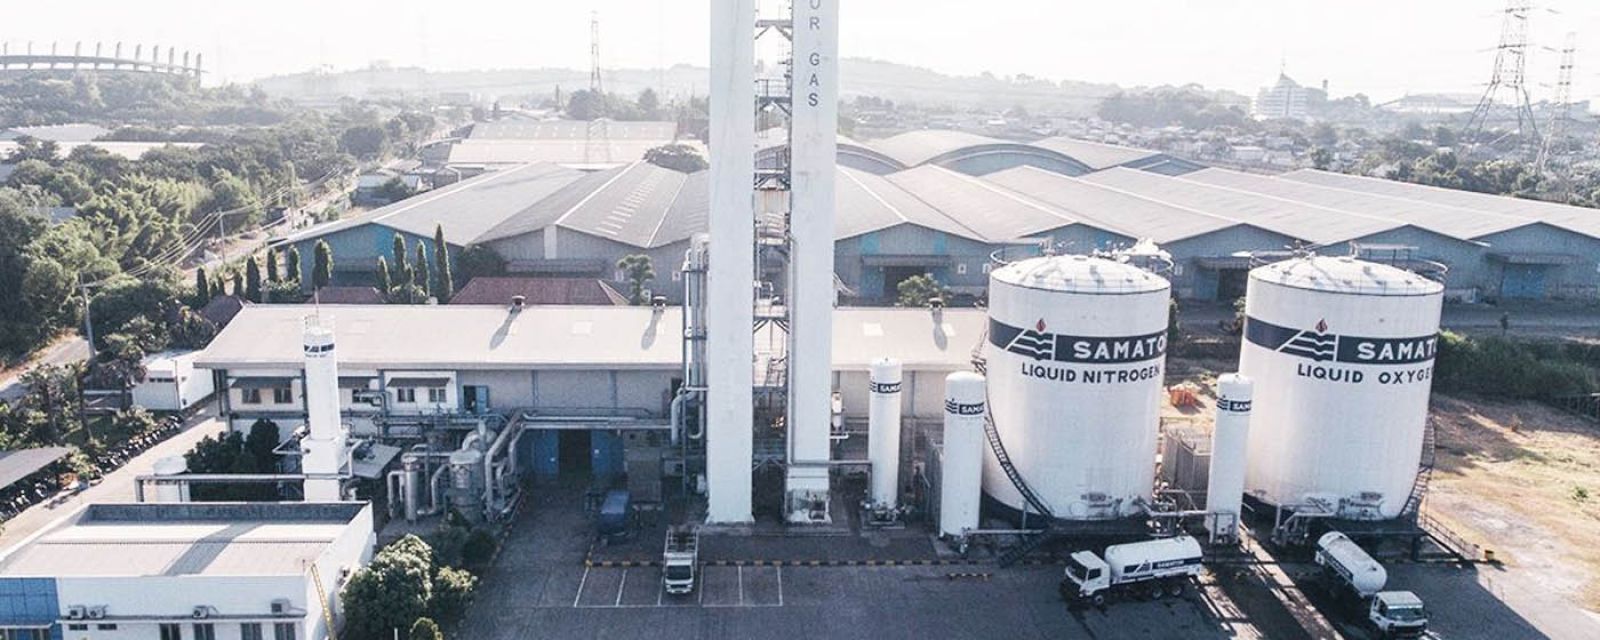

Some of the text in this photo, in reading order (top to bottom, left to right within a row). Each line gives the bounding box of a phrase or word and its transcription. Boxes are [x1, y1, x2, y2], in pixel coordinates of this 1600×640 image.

[808, 52, 820, 107] GAS
[1073, 333, 1168, 360] SAMATO
[1022, 363, 1160, 383] LIQUID NITROGEN
[1297, 363, 1433, 384] LIQUID OXYGE
